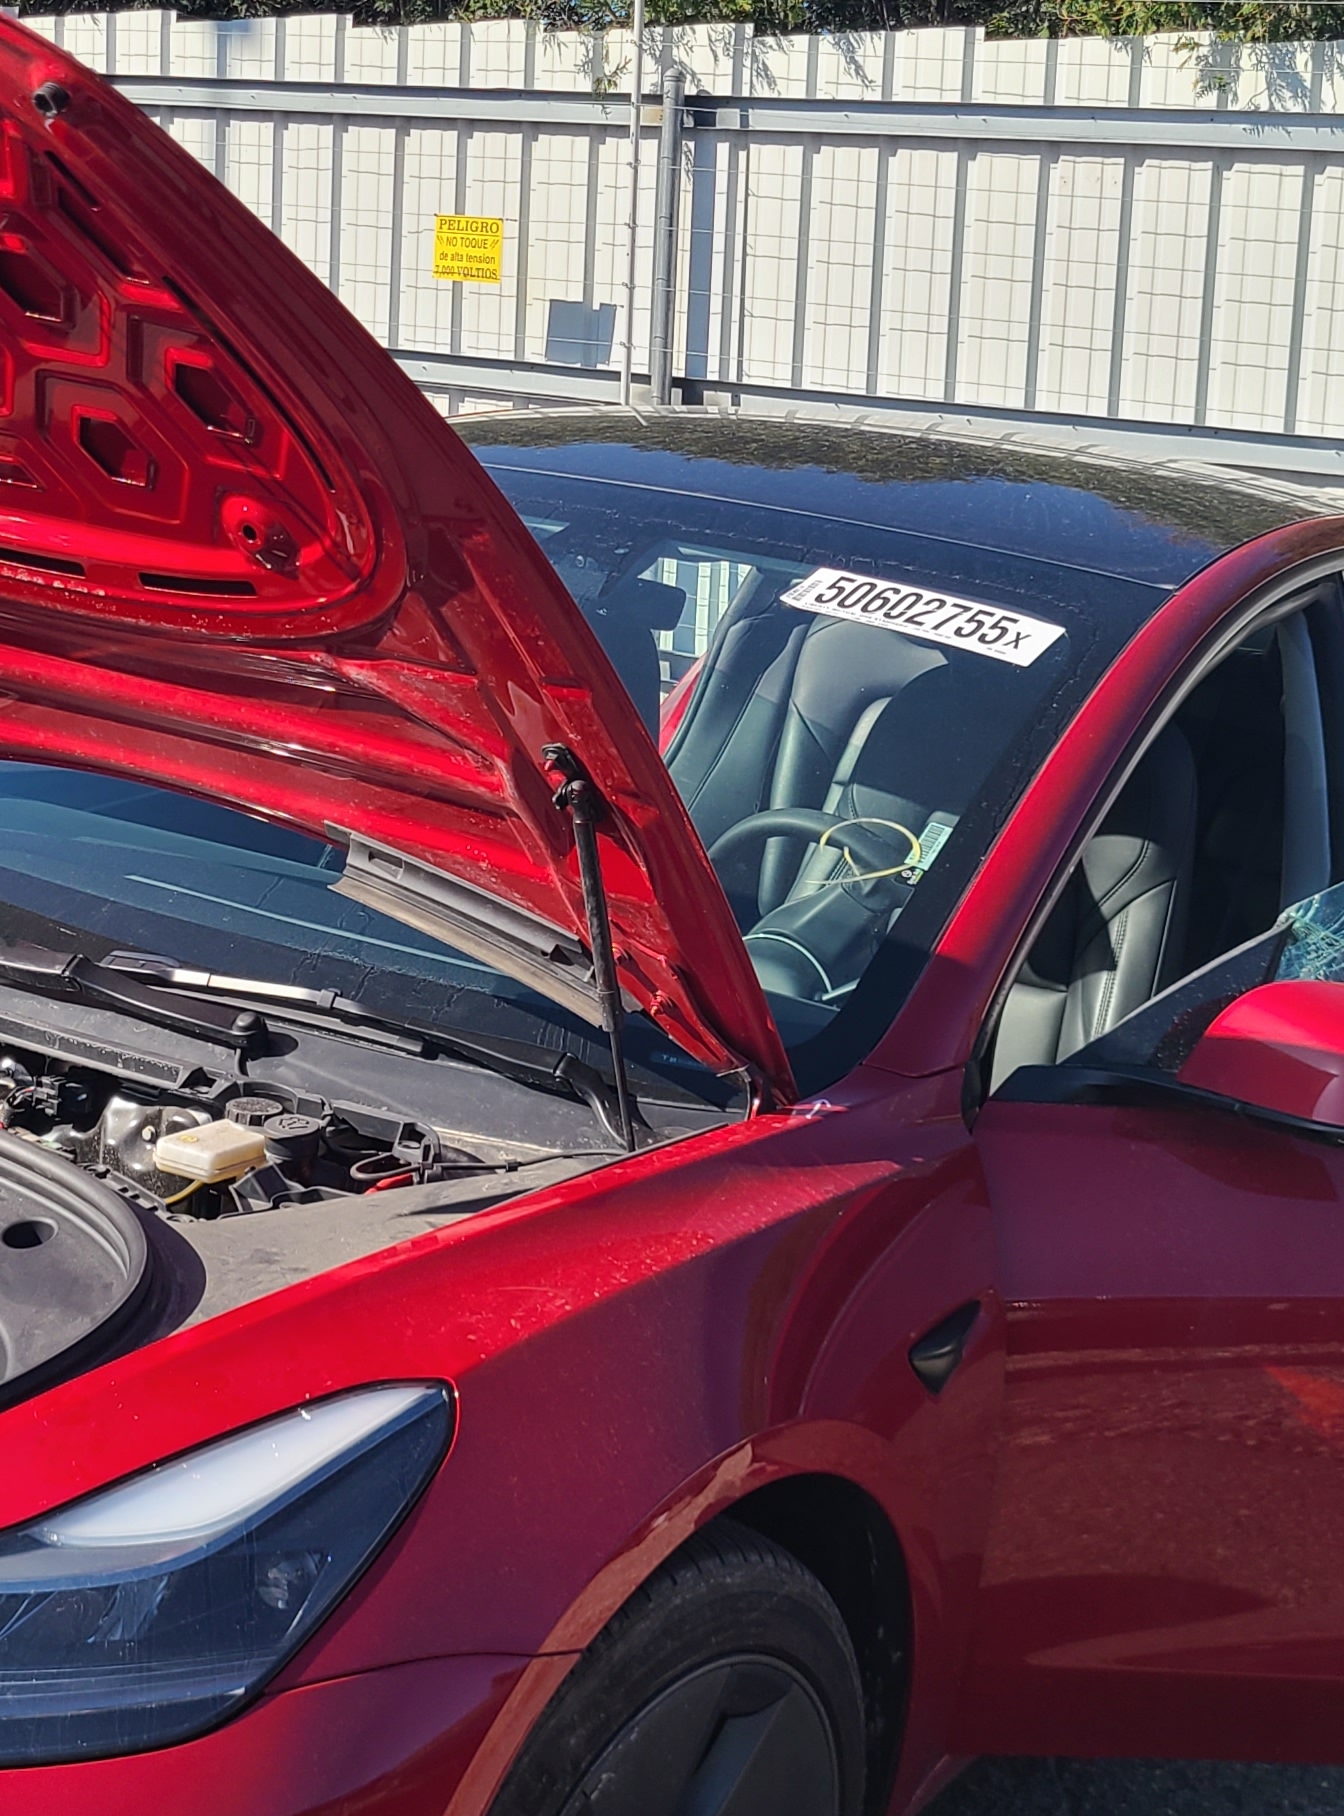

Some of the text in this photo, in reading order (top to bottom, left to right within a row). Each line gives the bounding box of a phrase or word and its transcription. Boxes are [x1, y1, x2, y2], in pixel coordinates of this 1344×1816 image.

[439, 218, 500, 234] PELIGRO
[446, 235, 489, 249] NO TOQUE
[439, 250, 449, 262] de
